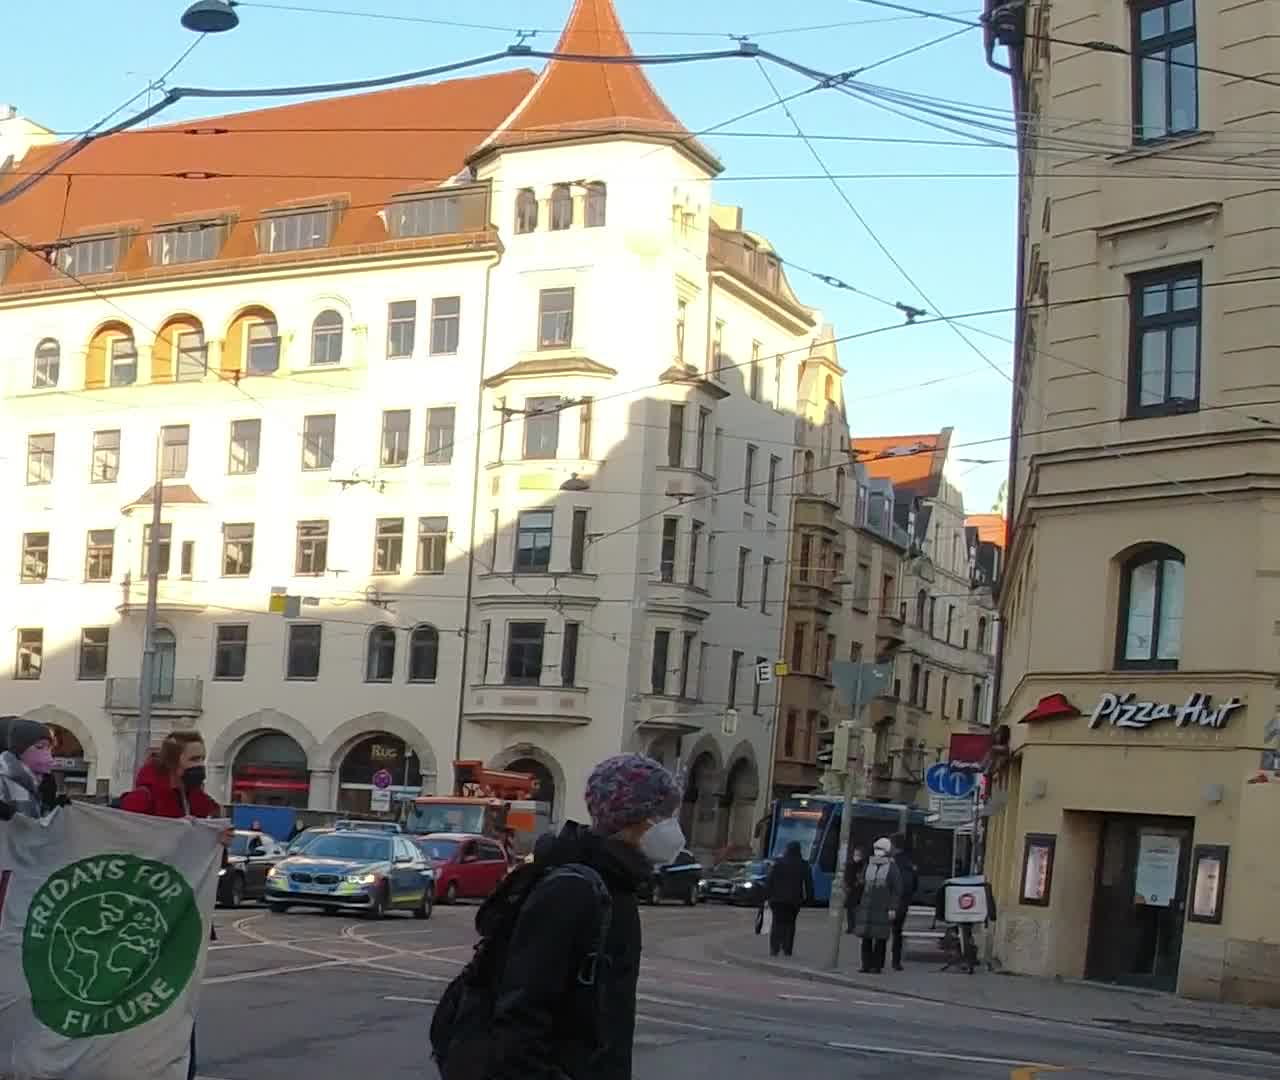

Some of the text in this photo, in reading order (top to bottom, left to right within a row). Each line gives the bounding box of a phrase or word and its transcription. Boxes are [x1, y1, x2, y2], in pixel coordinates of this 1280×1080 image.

[1087, 692, 1246, 729] Pizza Hut
[30, 858, 183, 940] FRIDAYS FOR
